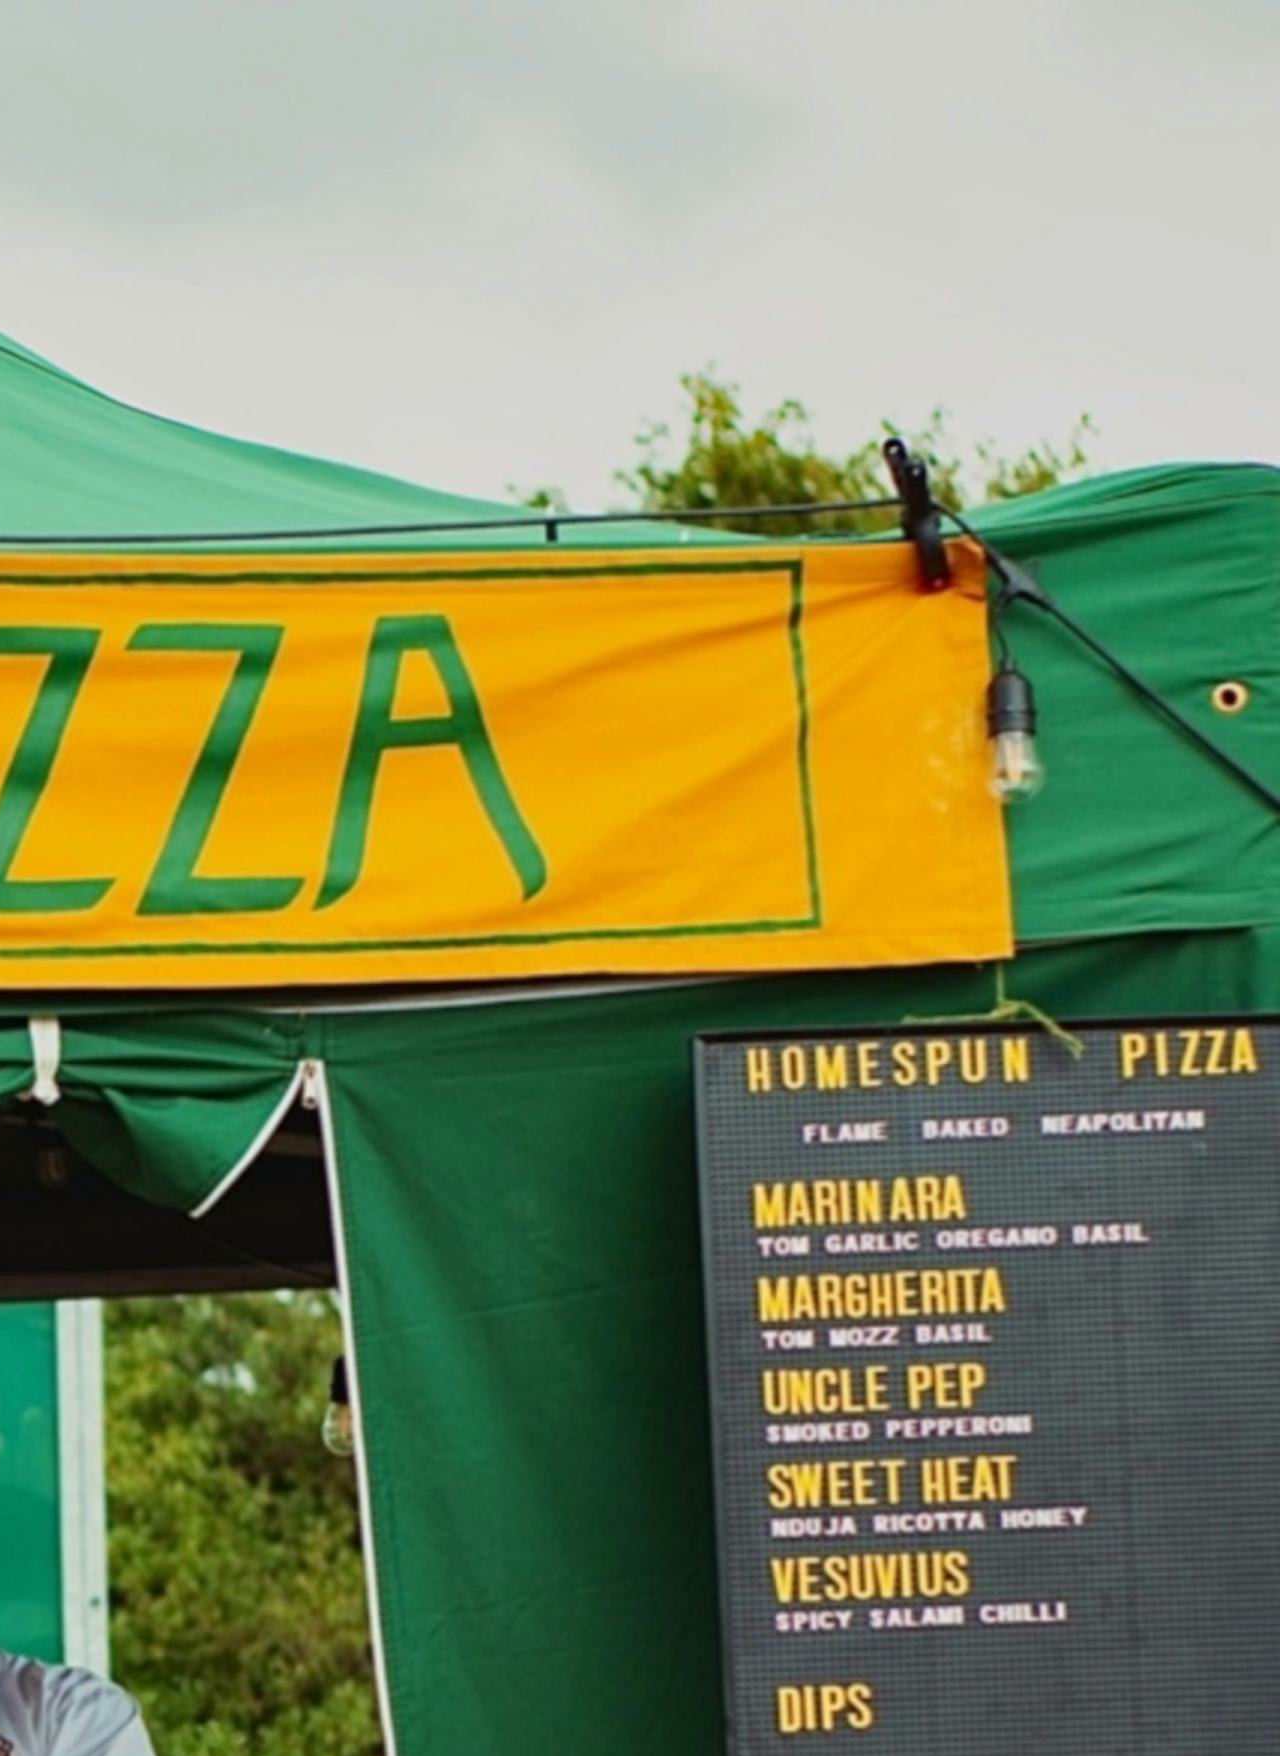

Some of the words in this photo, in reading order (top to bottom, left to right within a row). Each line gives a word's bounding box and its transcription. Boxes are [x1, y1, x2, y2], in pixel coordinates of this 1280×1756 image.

[745, 1036, 1031, 1094] HOMESPUN
[1119, 1027, 1259, 1080] PIZZA
[802, 1121, 887, 1144] FLAME
[921, 1116, 1010, 1140] BAKED
[1040, 1109, 1206, 1135] NEAPOLITAN
[752, 1174, 968, 1230] MARINARA
[756, 1235, 811, 1258] TOM
[824, 1231, 919, 1254] GARLIC
[935, 1225, 1058, 1250] OREGANO
[1071, 1223, 1149, 1245] BASIL
[756, 1266, 1007, 1324] MARGHERITA
[761, 1329, 815, 1350] TOM
[828, 1325, 900, 1348] MOZZ
[915, 1322, 991, 1345] BASIL
[762, 1364, 888, 1416] UNCLE
[906, 1361, 987, 1410] PEP
[765, 1420, 871, 1444] SMOKED
[885, 1414, 1033, 1439] PEPPERONI
[766, 1457, 905, 1510] SWEET
[920, 1453, 1016, 1505] HEAT
[770, 1515, 858, 1538] NDUJA
[872, 1510, 986, 1534] RICOTTA
[1000, 1506, 1087, 1530] HONEY
[769, 1549, 971, 1604] VESUVIUS
[774, 1609, 853, 1632] SPICY
[868, 1605, 965, 1629] SALAMI
[978, 1601, 1067, 1624] CHILLI
[776, 1682, 874, 1734] DIPS
